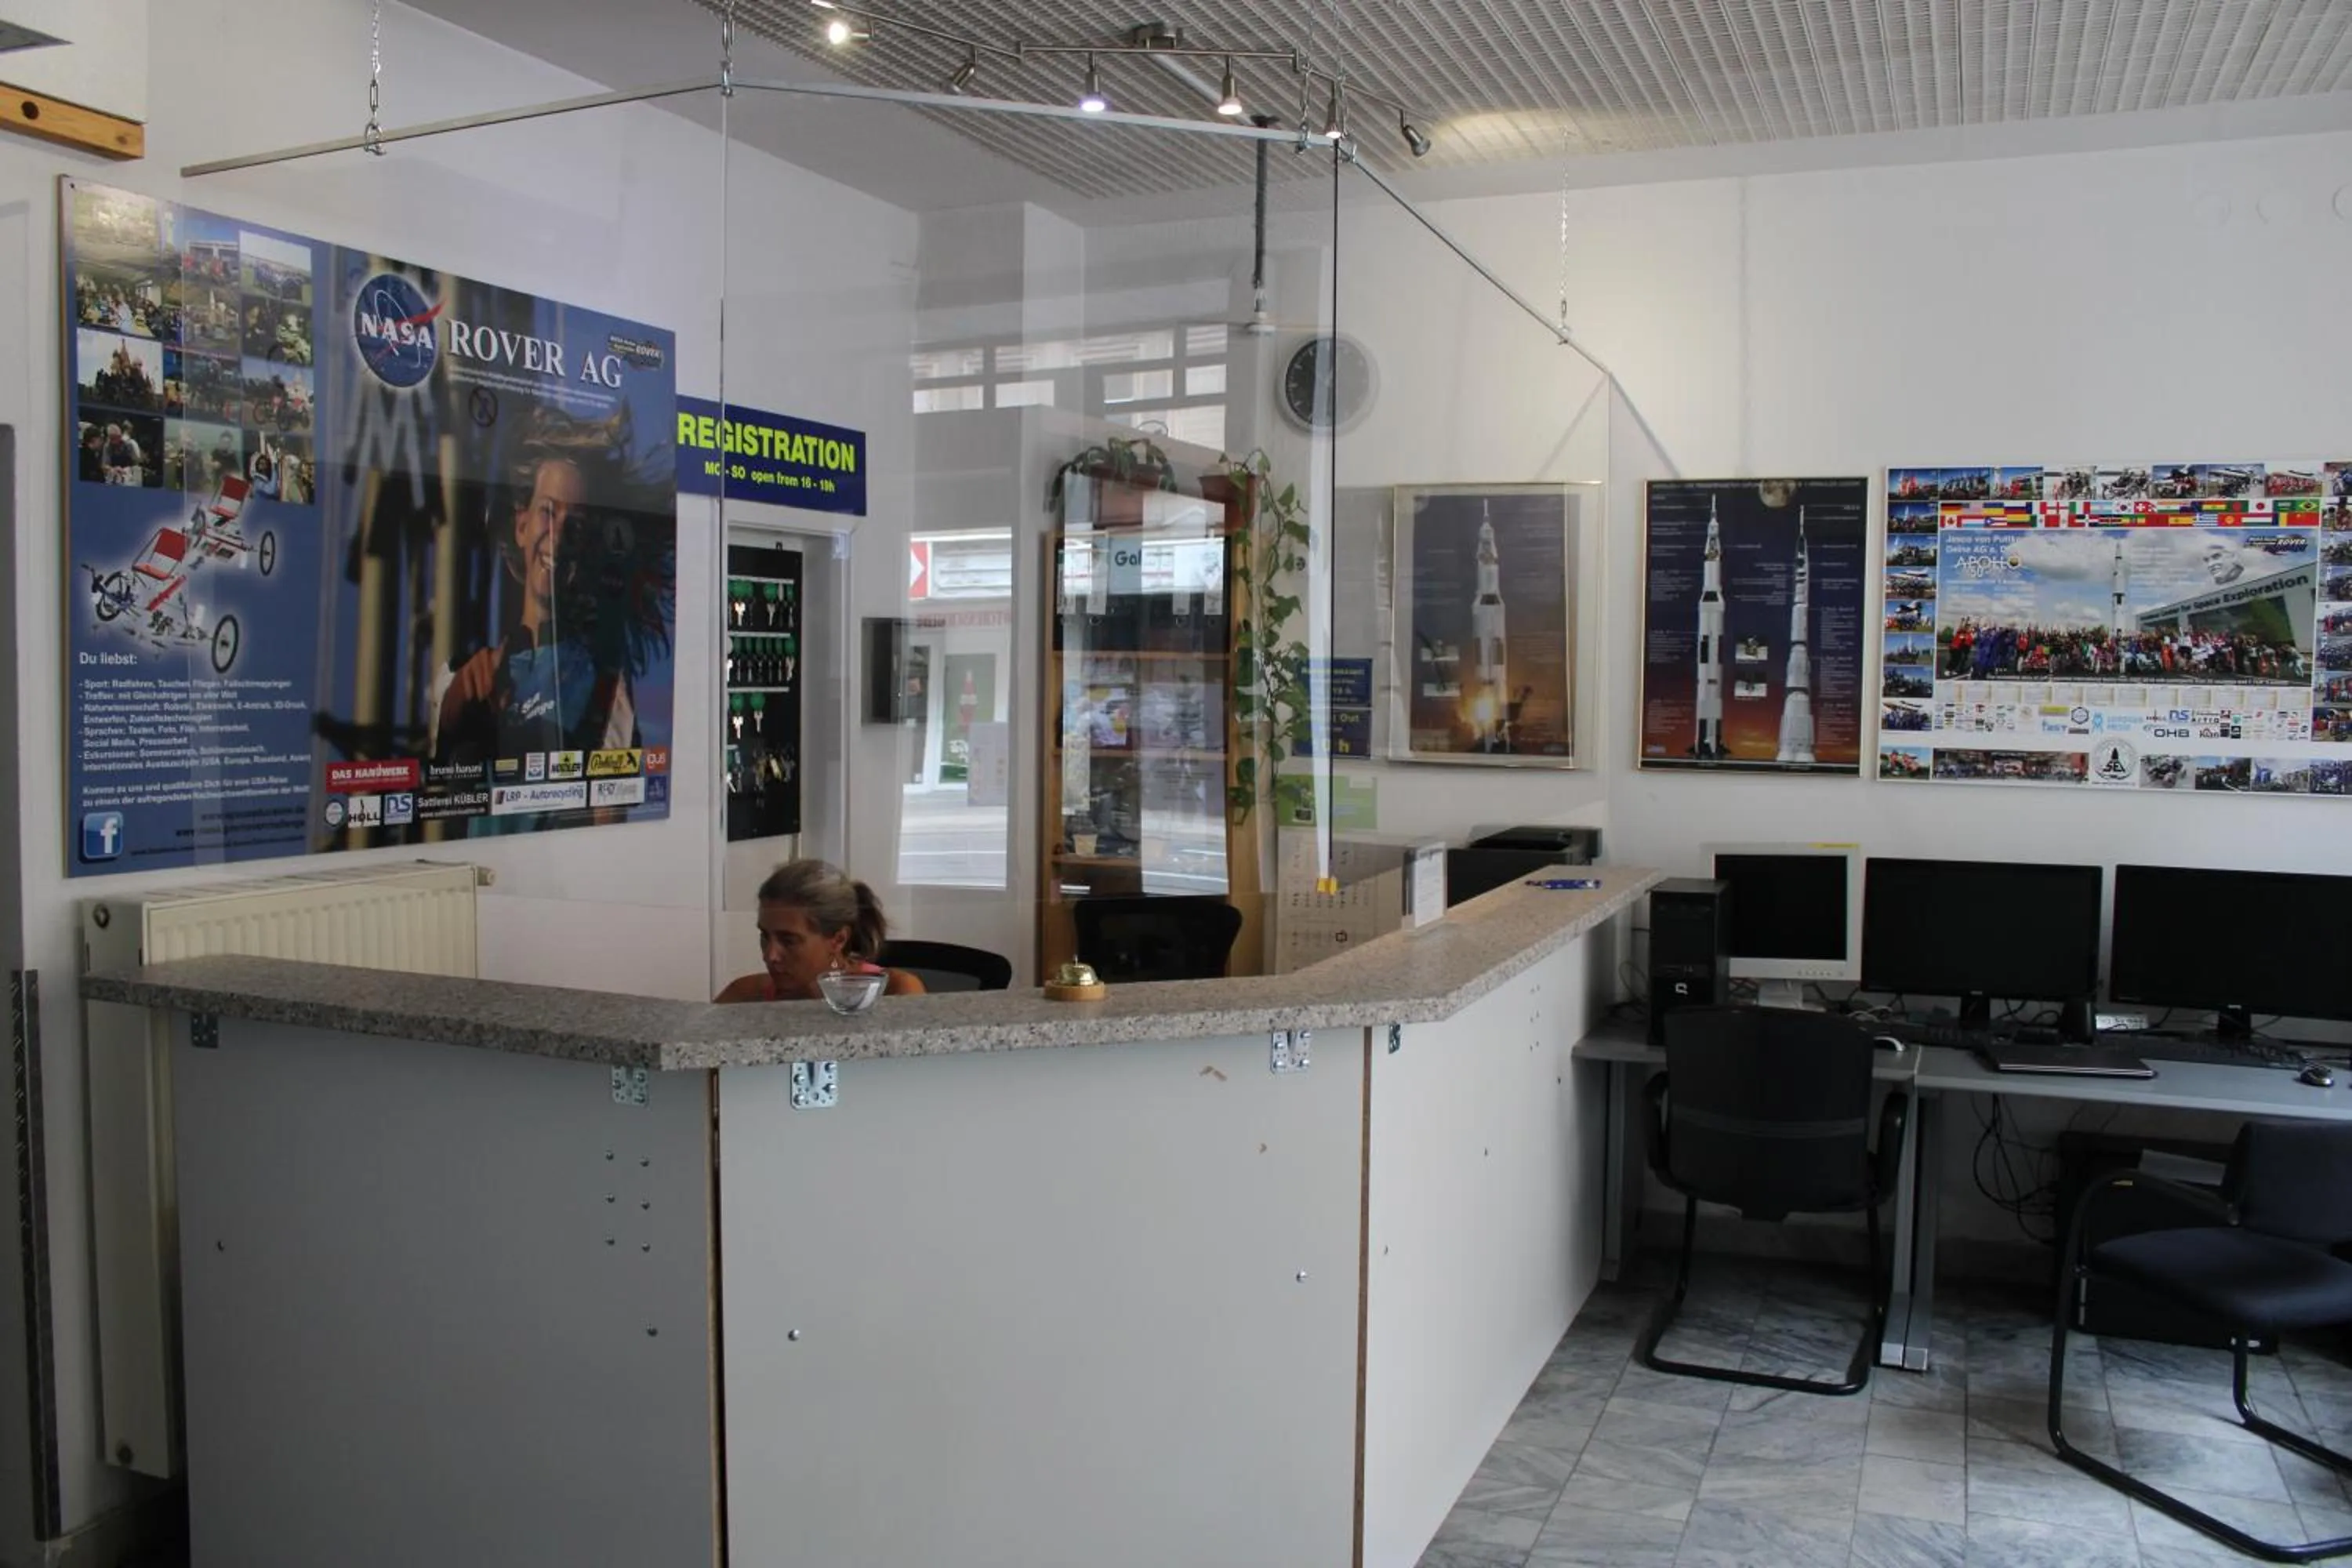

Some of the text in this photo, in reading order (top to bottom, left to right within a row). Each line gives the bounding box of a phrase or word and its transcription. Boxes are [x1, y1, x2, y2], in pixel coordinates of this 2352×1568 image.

[361, 312, 434, 350] NASA
[448, 318, 565, 377] ROVER
[580, 352, 622, 389] AG
[677, 412, 855, 473] REGISTRATION
[731, 465, 746, 479] SO
[750, 470, 775, 485] open
[777, 472, 799, 486] from
[1955, 555, 2023, 569] APOLLO
[2223, 574, 2309, 603] Exploration
[79, 652, 137, 665] Du liebst:
[2154, 728, 2190, 738] OHB
[332, 764, 410, 780] DAS HANDWERK
[530, 786, 584, 802] Autorecycling
